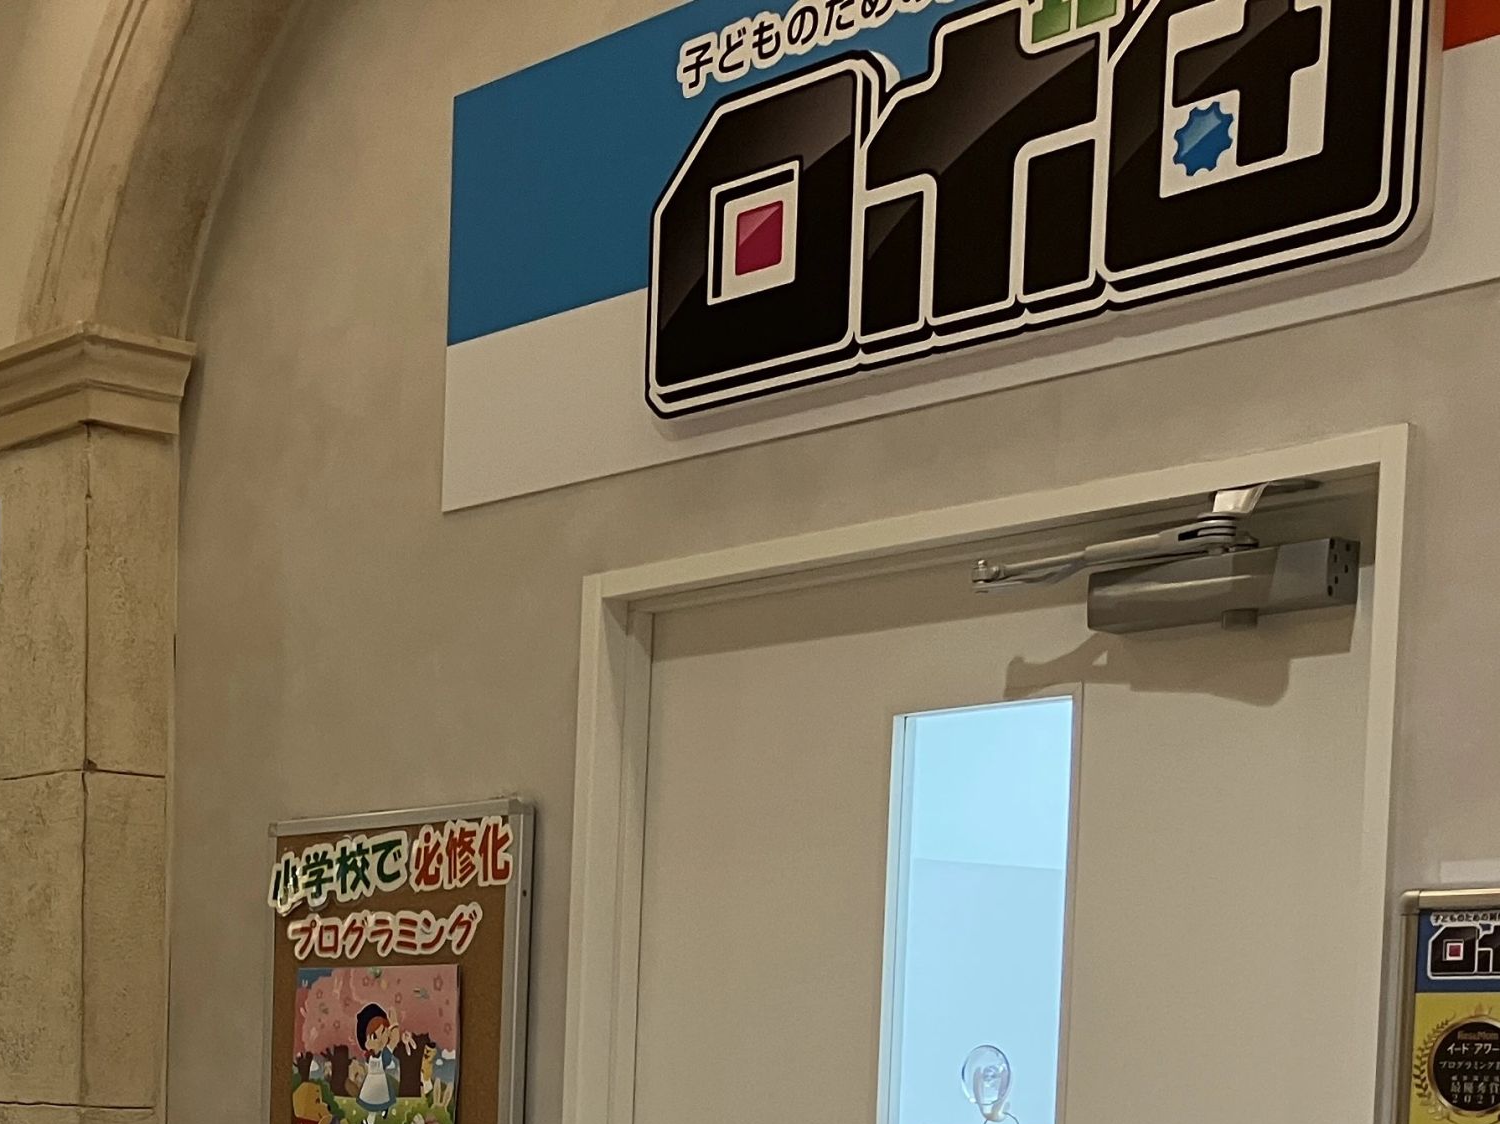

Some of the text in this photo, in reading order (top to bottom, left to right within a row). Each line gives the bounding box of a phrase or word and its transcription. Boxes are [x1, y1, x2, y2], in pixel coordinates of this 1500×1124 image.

[273, 825, 510, 902] 小学校で 必修化
[290, 912, 477, 956] プログラミング
[1447, 1043, 1469, 1056] イード
